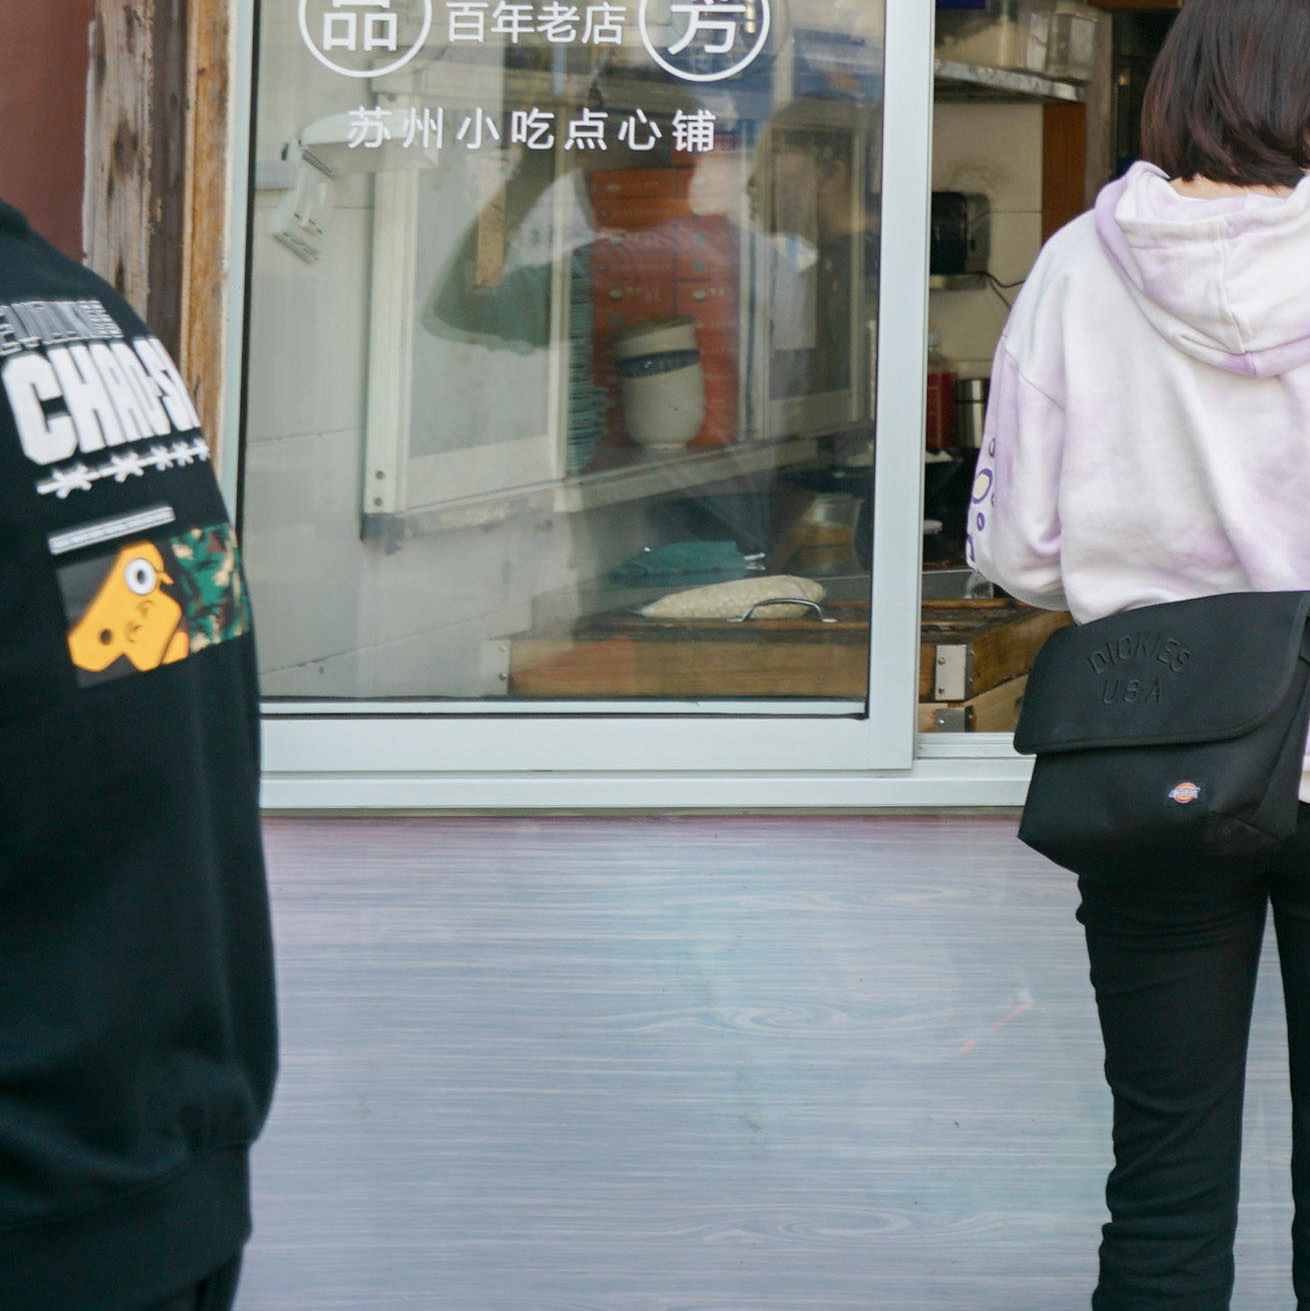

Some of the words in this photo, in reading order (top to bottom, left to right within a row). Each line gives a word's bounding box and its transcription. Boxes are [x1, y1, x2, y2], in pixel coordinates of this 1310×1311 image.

[446, 0, 627, 46] 百年老店
[346, 107, 717, 153] 苏州小吃点心铺
[1087, 634, 1192, 673] DICKIES
[1103, 678, 1160, 704] USA
